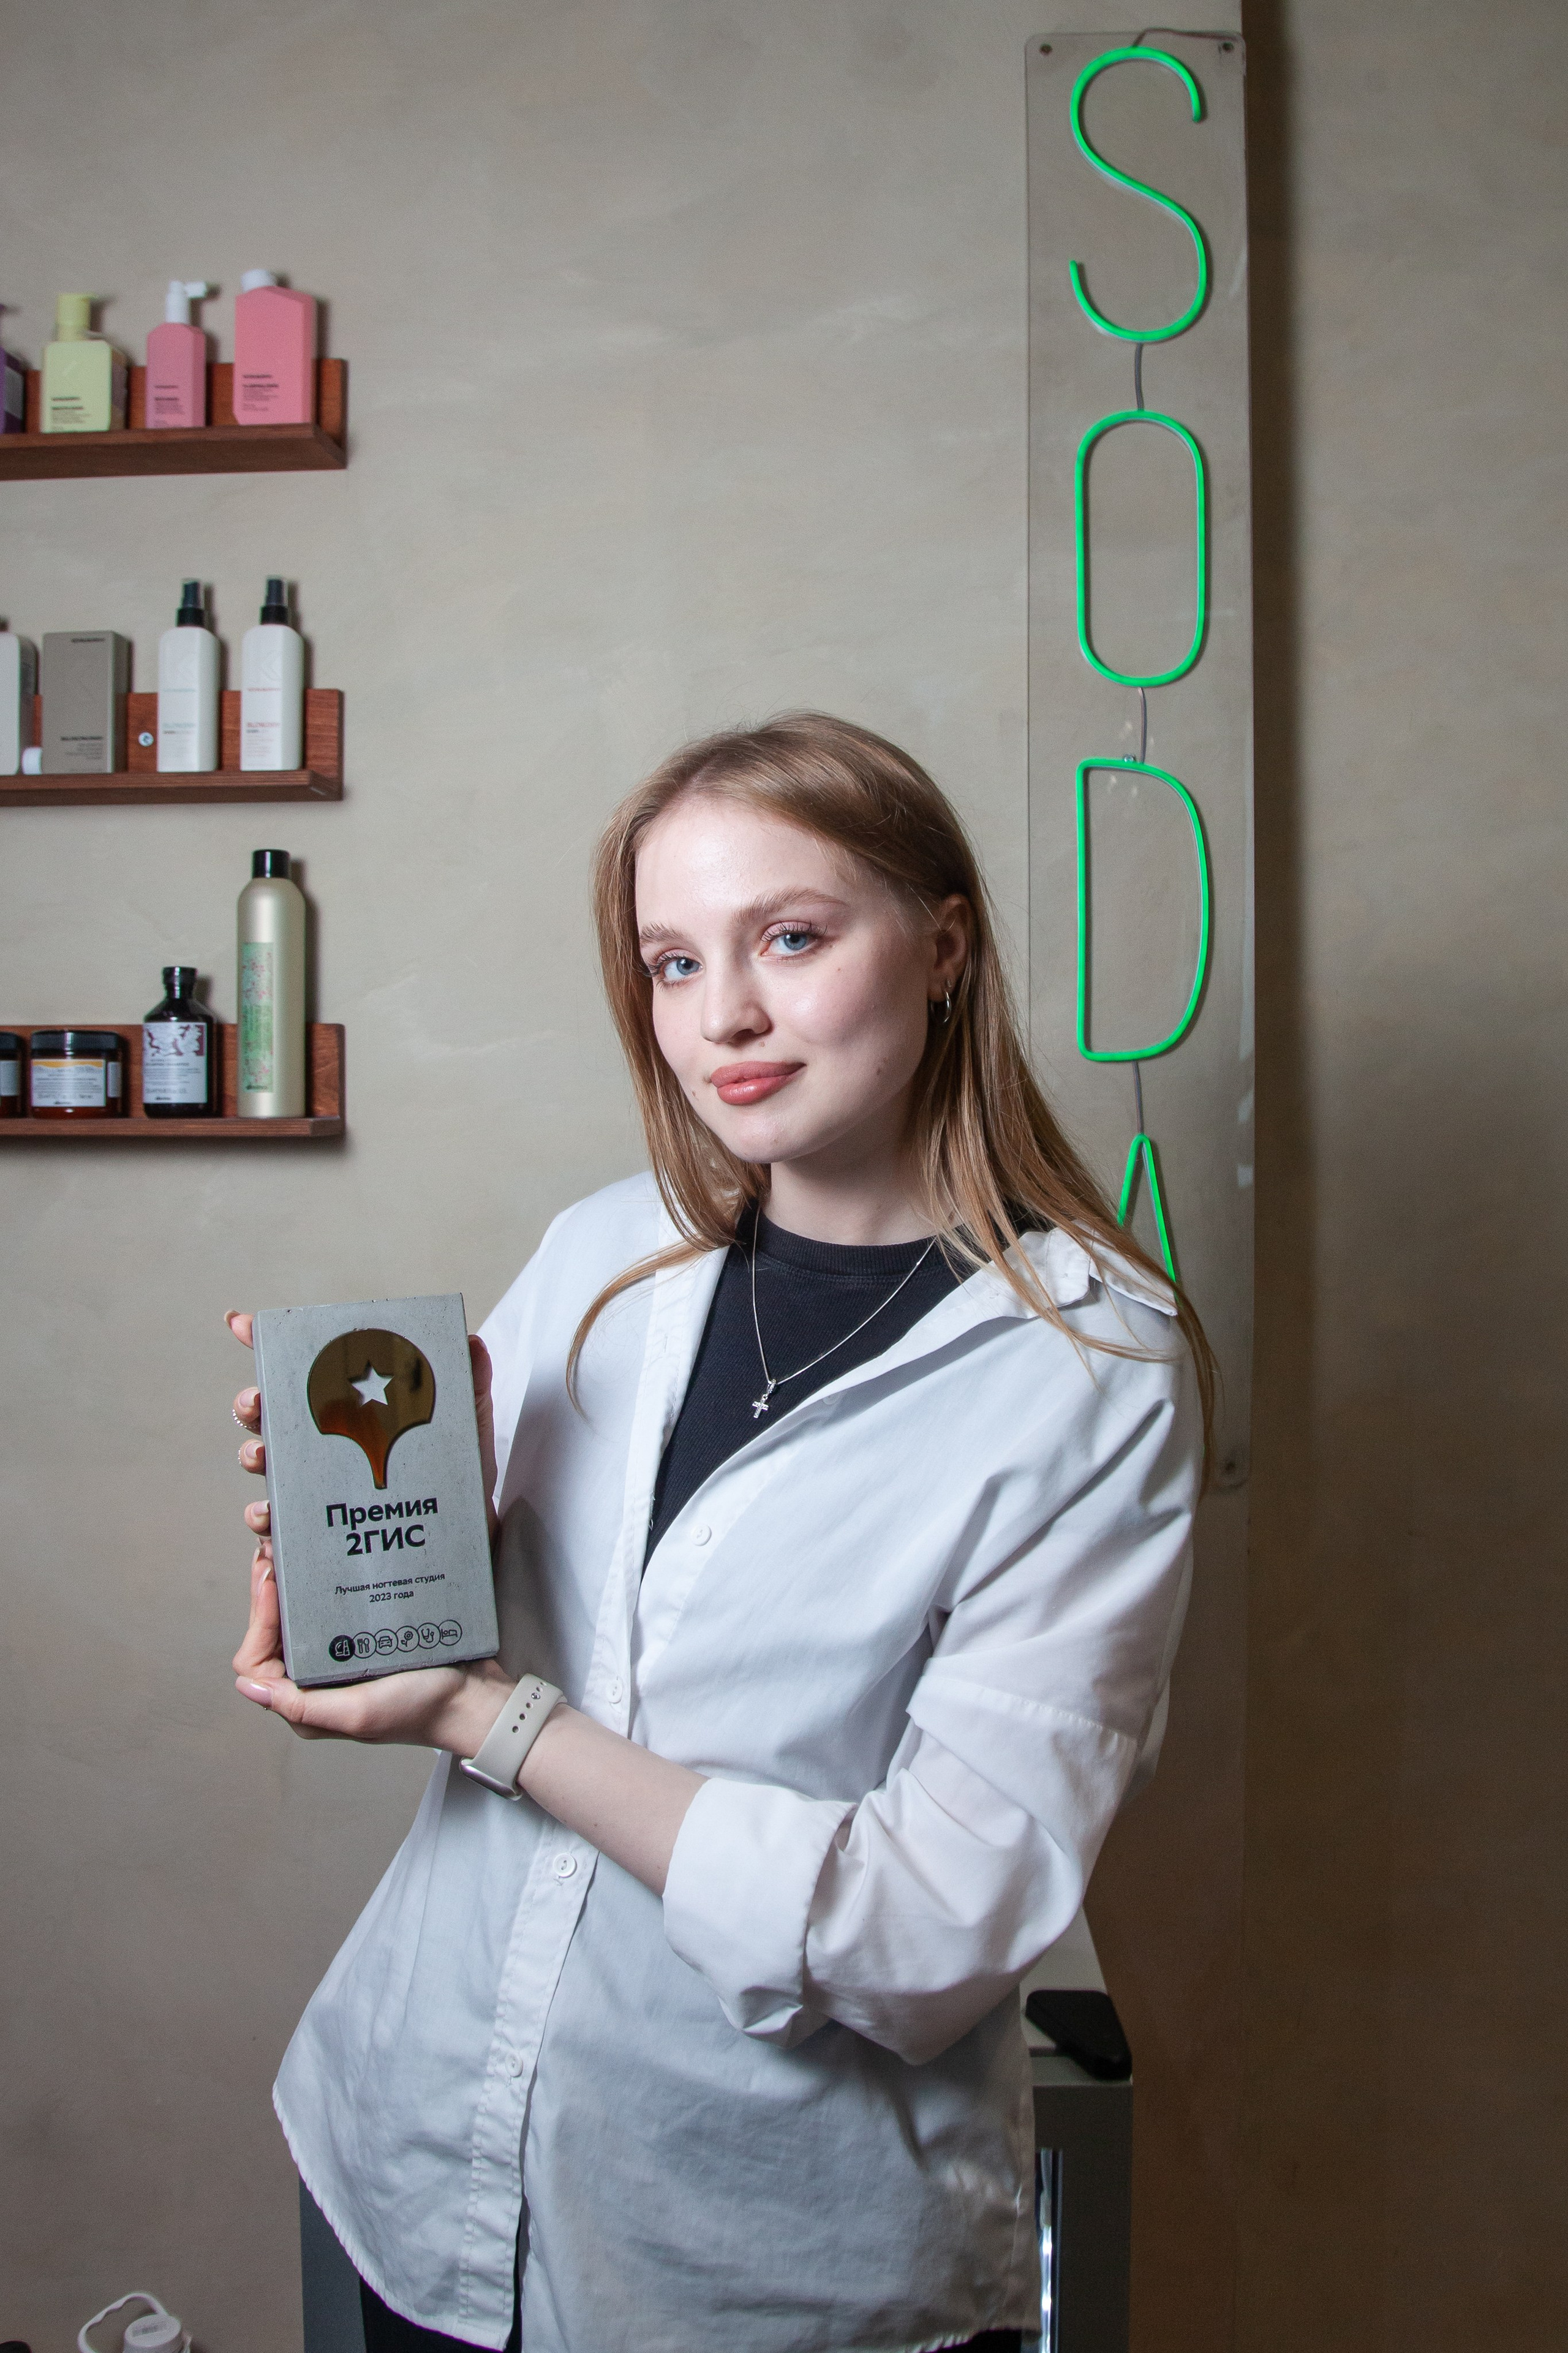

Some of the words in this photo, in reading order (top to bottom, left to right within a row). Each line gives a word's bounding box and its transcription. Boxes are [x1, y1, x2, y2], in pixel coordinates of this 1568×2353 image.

[326, 1497, 439, 1531] Премия
[345, 1524, 426, 1556] 2ГИС
[334, 1584, 371, 1595] Лучшая
[372, 1578, 413, 1588] ногтевая
[415, 1573, 445, 1585] студия
[369, 1593, 392, 1603] 2023
[394, 1590, 414, 1600] года
